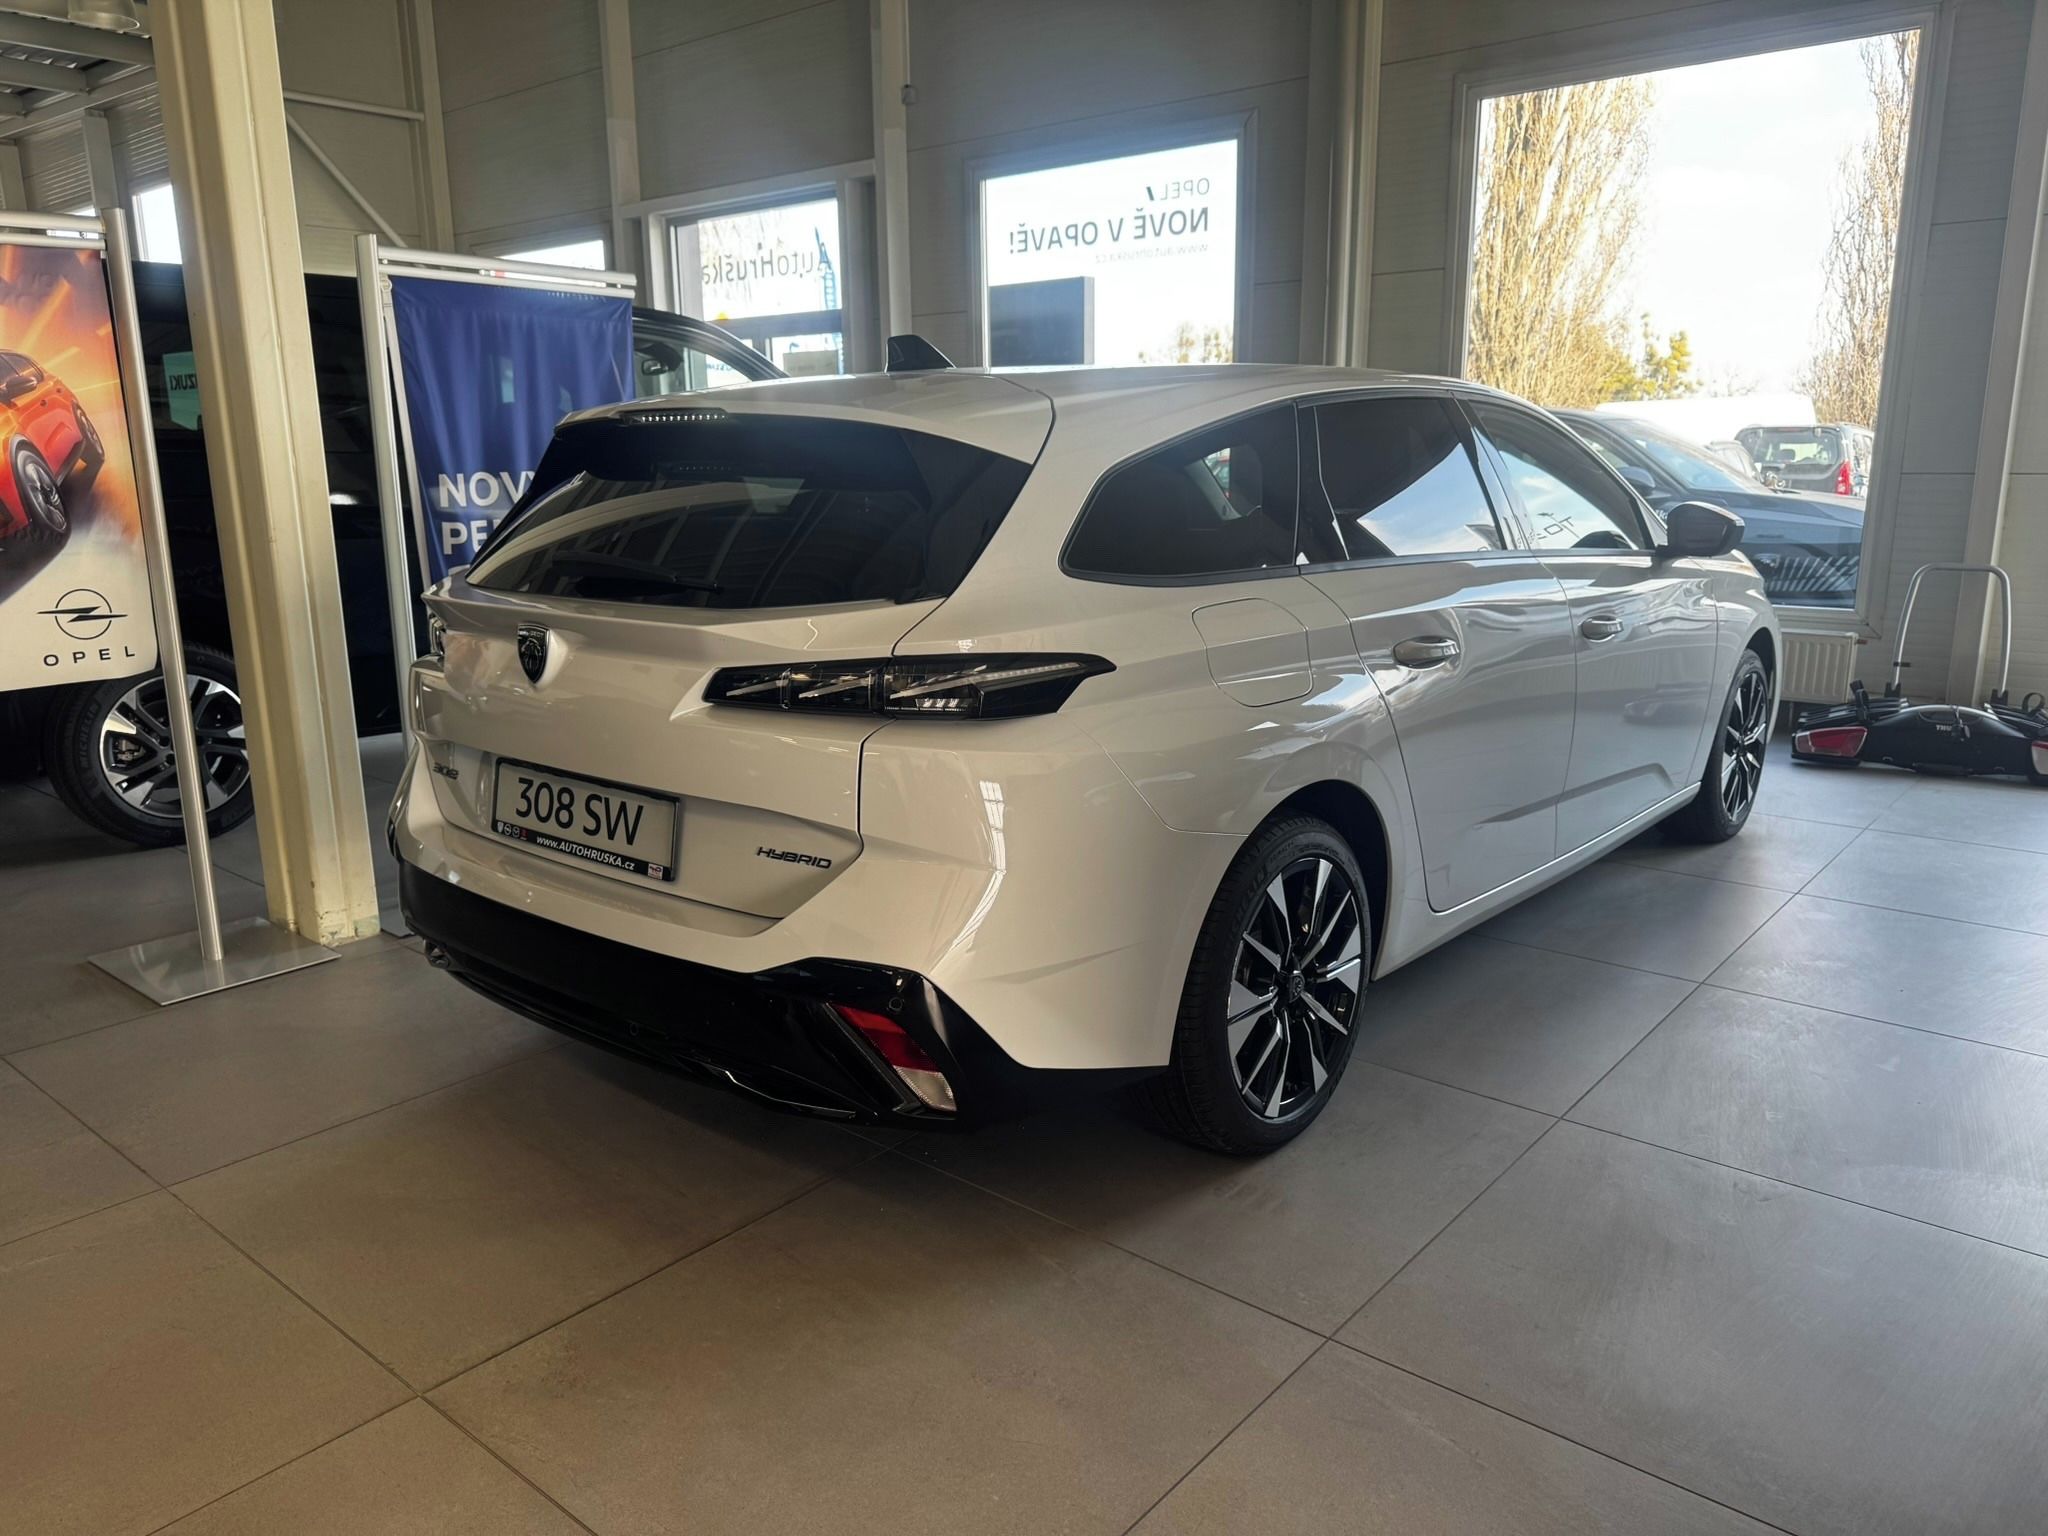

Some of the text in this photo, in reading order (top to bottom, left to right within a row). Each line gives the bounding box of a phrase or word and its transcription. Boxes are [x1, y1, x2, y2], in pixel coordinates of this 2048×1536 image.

[438, 471, 536, 508] NOV
[441, 519, 501, 555] PE
[43, 646, 136, 667] OPEL
[515, 777, 645, 846] 308 SW
[536, 835, 636, 872] www.AUTOHRUSKA.cz
[756, 846, 832, 869] HYBRID
